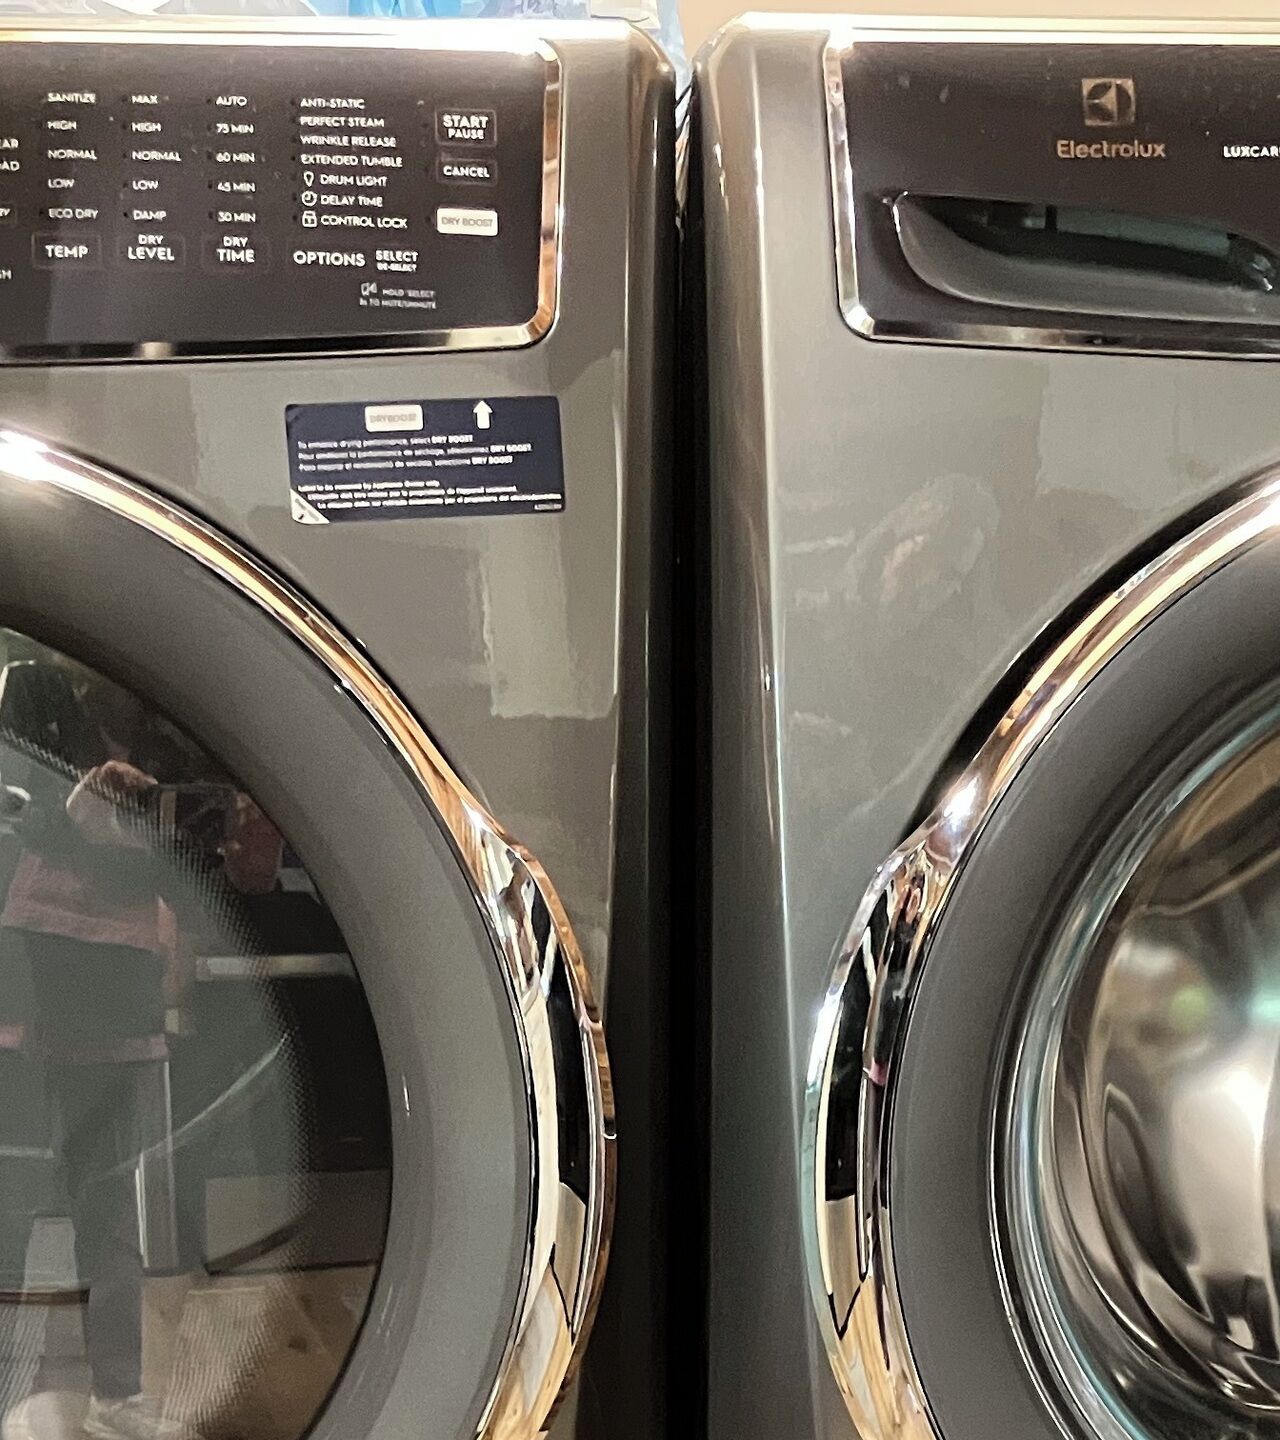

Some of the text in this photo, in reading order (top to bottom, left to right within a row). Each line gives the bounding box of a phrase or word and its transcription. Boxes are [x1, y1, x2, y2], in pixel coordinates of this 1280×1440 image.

[47, 92, 96, 104] SANITIZE
[132, 95, 158, 104] MAX
[216, 96, 248, 106] AUTO
[300, 98, 365, 110] ANTI-STATIC
[47, 121, 77, 130] HIGH
[132, 122, 162, 132] HIGH
[300, 116, 384, 128] PERFECT STEAM
[442, 114, 489, 129] START
[216, 124, 254, 134] 75 MIN
[448, 128, 484, 140] PAUSE
[300, 136, 396, 148] WRINKLE RELEASE
[47, 150, 98, 160] NORMAL
[1056, 140, 1167, 159] Electrolux
[132, 151, 182, 162] NORMAL
[216, 152, 255, 164] 60 MIN
[300, 154, 403, 168] EXTENDED TUMBLE
[443, 165, 490, 178] CANCEL
[48, 178, 75, 188] LOW
[132, 180, 159, 190] LOW
[320, 174, 388, 187] DRUM LIGHT
[218, 182, 256, 192] 45 MIN
[320, 194, 383, 208] DELAY TIME
[48, 208, 98, 220] ECO DRY
[133, 210, 166, 221] DAMP
[218, 212, 256, 222] 30 MIN
[320, 215, 408, 229] CONTROL LOCK
[442, 216, 493, 228] DRY BOOST
[138, 234, 164, 245] DRY
[223, 236, 248, 247] DRY
[45, 245, 88, 258] TEMP
[128, 246, 175, 262] LEVEL
[217, 248, 255, 263] TIME
[376, 250, 418, 262] SELECT
[293, 250, 366, 267] OPTIONS
